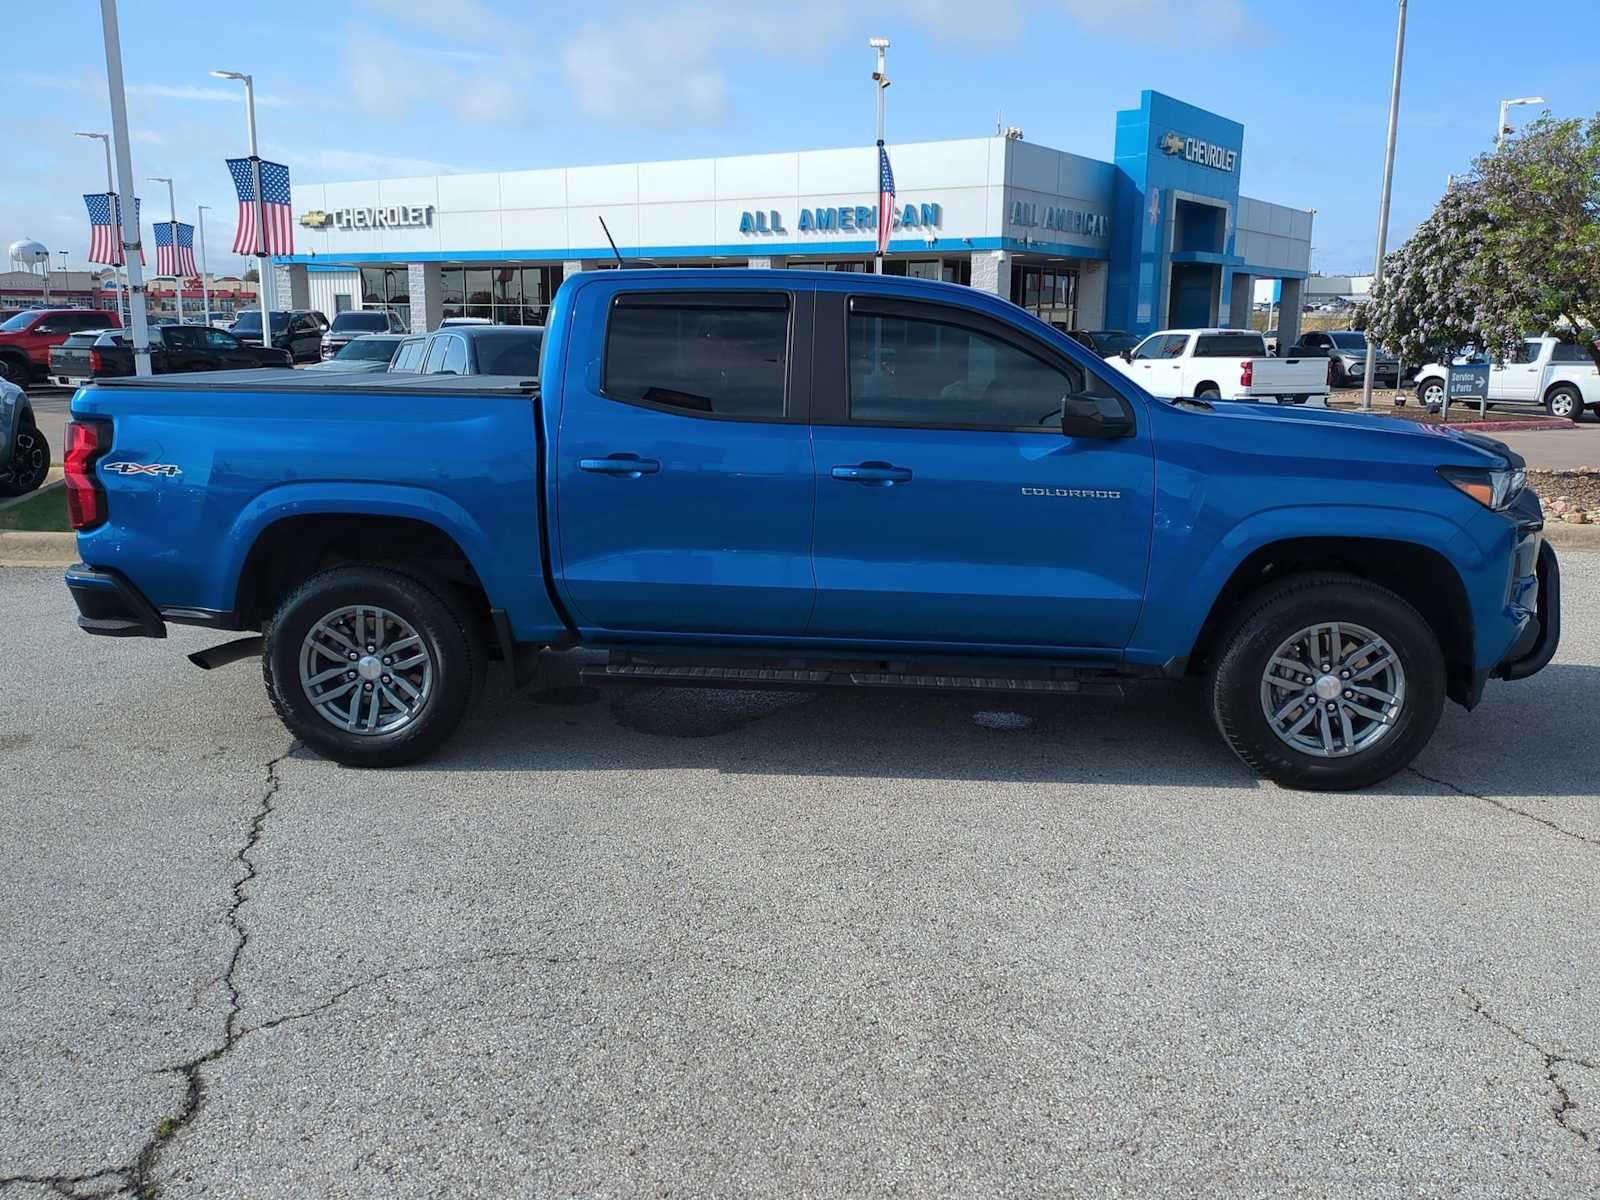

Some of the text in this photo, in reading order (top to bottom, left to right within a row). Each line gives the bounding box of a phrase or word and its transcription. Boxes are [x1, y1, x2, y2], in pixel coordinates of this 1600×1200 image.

[1185, 137, 1237, 172] CHEVROLET
[333, 205, 433, 230] CHEVROLET
[739, 203, 942, 234] ALL AMERIAN
[1009, 200, 1038, 227] ALL
[1451, 372, 1474, 382] Service
[1456, 384, 1473, 393] Parts
[1021, 487, 1121, 499] COLORADO
